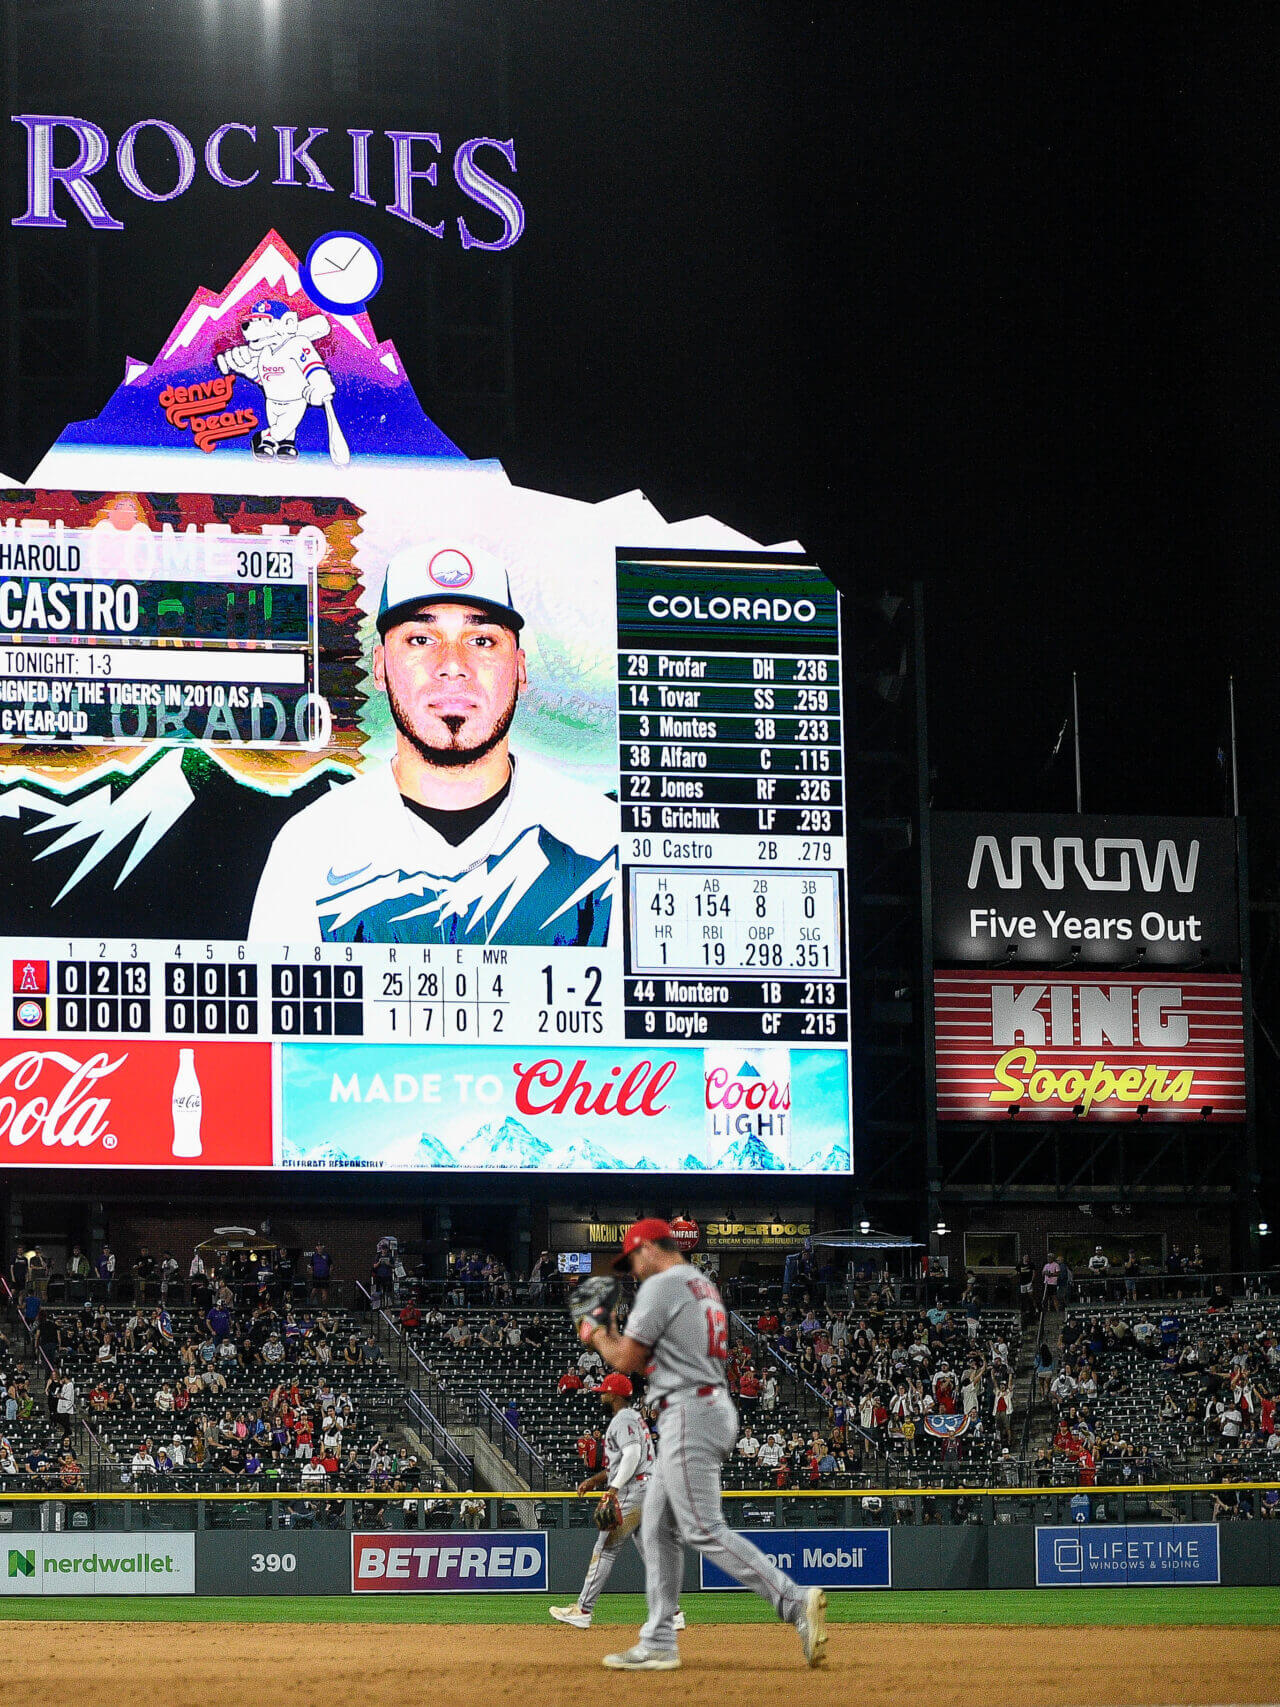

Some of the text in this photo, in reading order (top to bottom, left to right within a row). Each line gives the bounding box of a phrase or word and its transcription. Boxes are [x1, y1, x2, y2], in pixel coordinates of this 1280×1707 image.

[11, 114, 525, 251] ROCKIES
[159, 374, 236, 418] denver
[190, 408, 259, 444] bears
[0, 543, 293, 579] HAROLD 30 2B
[648, 594, 817, 623] COLORADO
[5, 651, 112, 676] TONIGHT: 1-3
[627, 655, 828, 682] 29 Profar DH .236
[51, 681, 72, 704] BY
[75, 682, 104, 705] THE
[107, 682, 162, 706] TIGERS
[164, 684, 182, 706] IN
[184, 684, 224, 708] 2010
[228, 685, 249, 708] AS
[252, 686, 265, 709] A
[629, 685, 829, 712] 14 Tovar SS .259
[659, 716, 829, 742] Montes 3B .233
[629, 745, 830, 772] 38 Alfaro .115
[629, 776, 831, 802] 22 Jones RF .326
[631, 806, 832, 832] 15 Grichuk LF .293
[632, 838, 832, 862] 30 Castro 2B .279
[968, 835, 1201, 894] ARROW
[650, 893, 731, 918] 43 154
[969, 908, 1202, 942] Five Years Out
[482, 949, 508, 965] MVR
[702, 943, 830, 968] 19 .298 .351
[124, 966, 438, 997] 13 25 28
[633, 980, 836, 1006] 44 Montero 1B .213
[538, 1010, 604, 1034] 2 OUTS
[665, 1012, 836, 1038] Doyle CF .215
[991, 984, 1191, 1048] KING
[330, 1058, 678, 1118] MADE TO Chill
[705, 1067, 791, 1111] Coors
[988, 1047, 1196, 1118] Soopers
[713, 1112, 786, 1137] LIGHT
[589, 1223, 619, 1243] NACHO
[670, 1230, 698, 1239] ANFARE
[706, 1223, 811, 1236] SUPER DOG
[44, 1553, 174, 1573] nerdwallet
[250, 1553, 297, 1573] 390
[357, 1547, 543, 1578] BETFRED
[803, 1548, 864, 1568] Mobil
[1089, 1541, 1199, 1559] LIFETIME
[1089, 1560, 1200, 1570] WINDOWS & SIDING
